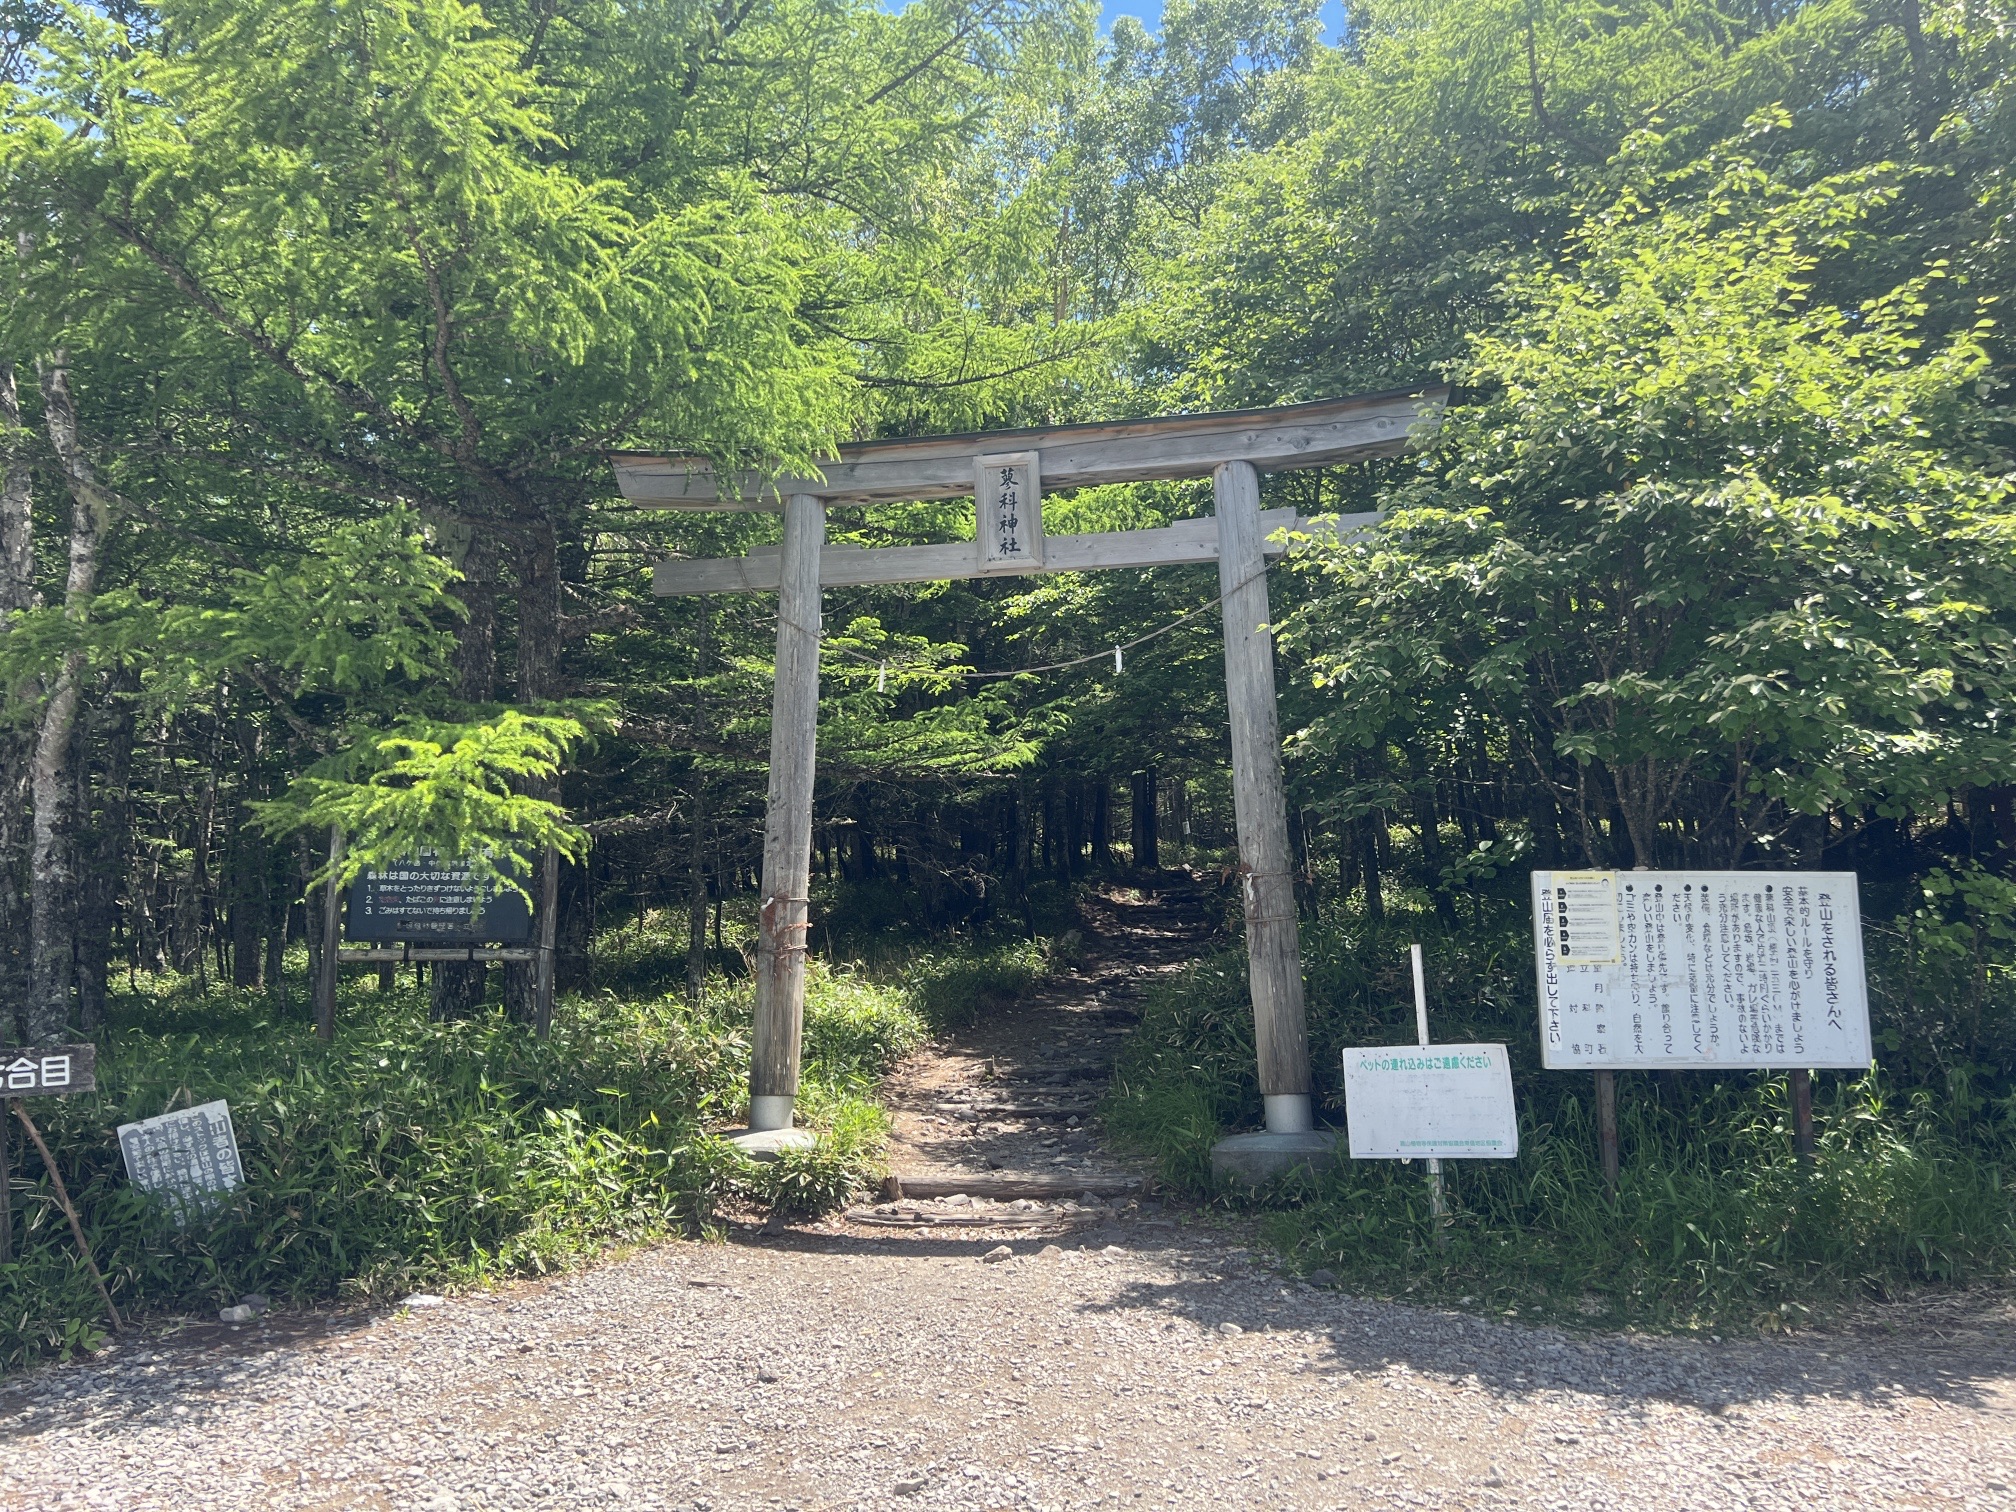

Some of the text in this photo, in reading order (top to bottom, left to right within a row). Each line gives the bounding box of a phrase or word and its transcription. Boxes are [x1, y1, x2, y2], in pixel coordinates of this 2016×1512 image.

[998, 467, 1022, 556] 蓼科神社
[378, 906, 486, 915] ごみはすてないで持ち帰りましう
[1671, 892, 1682, 927] ださい。
[1718, 892, 1734, 1008] う充分注意してください。
[1797, 886, 1814, 980] 基本的ルールを守り
[1782, 886, 1805, 1054] 安全で楽しい登山を心がけましょう
[1817, 893, 1843, 1031] 登山をされる皆さんへ
[0, 1055, 70, 1090] 合目
[1359, 1055, 1492, 1072] ペットの連れ込みはご遠慮ください
